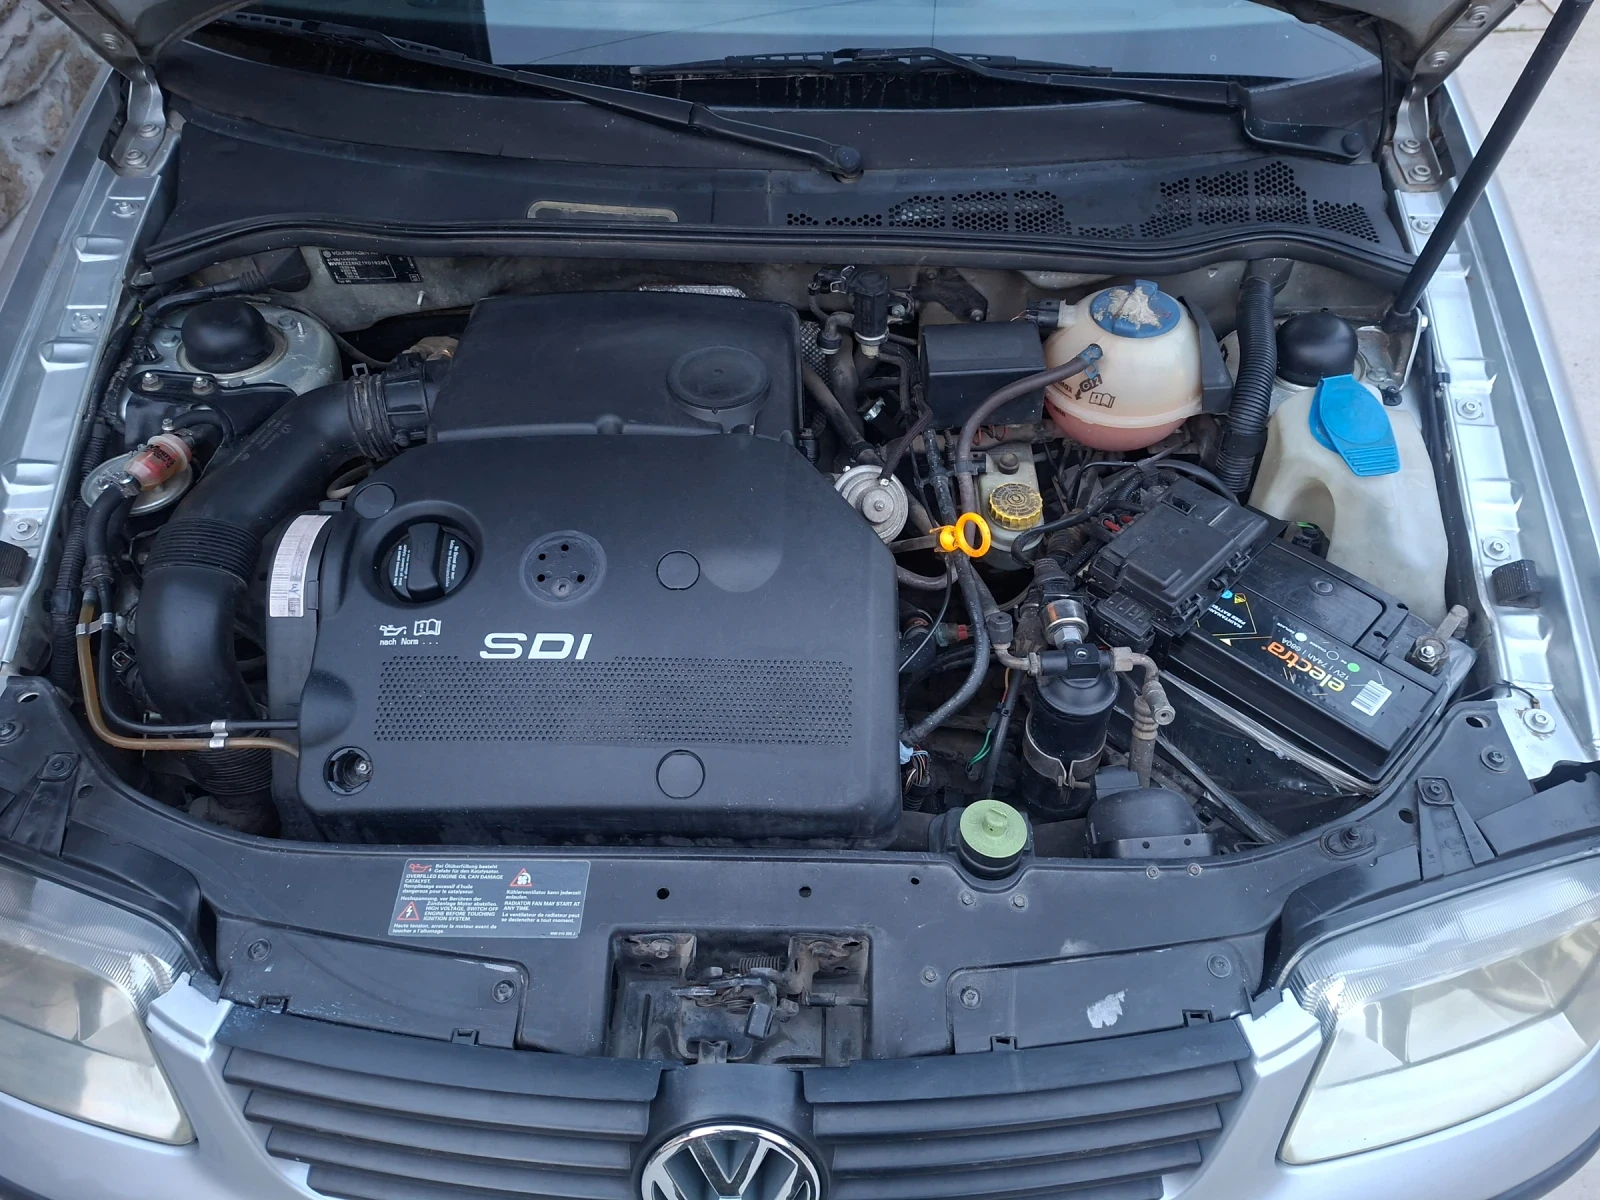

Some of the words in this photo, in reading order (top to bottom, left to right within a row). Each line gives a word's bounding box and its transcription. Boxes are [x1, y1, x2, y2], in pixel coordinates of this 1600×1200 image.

[1082, 377, 1100, 390] G12
[479, 633, 593, 659] SDI
[1281, 636, 1302, 652] 680A
[1267, 641, 1345, 692] electra
[1309, 653, 1333, 672] 74Ah
[1334, 669, 1349, 681] 12V
